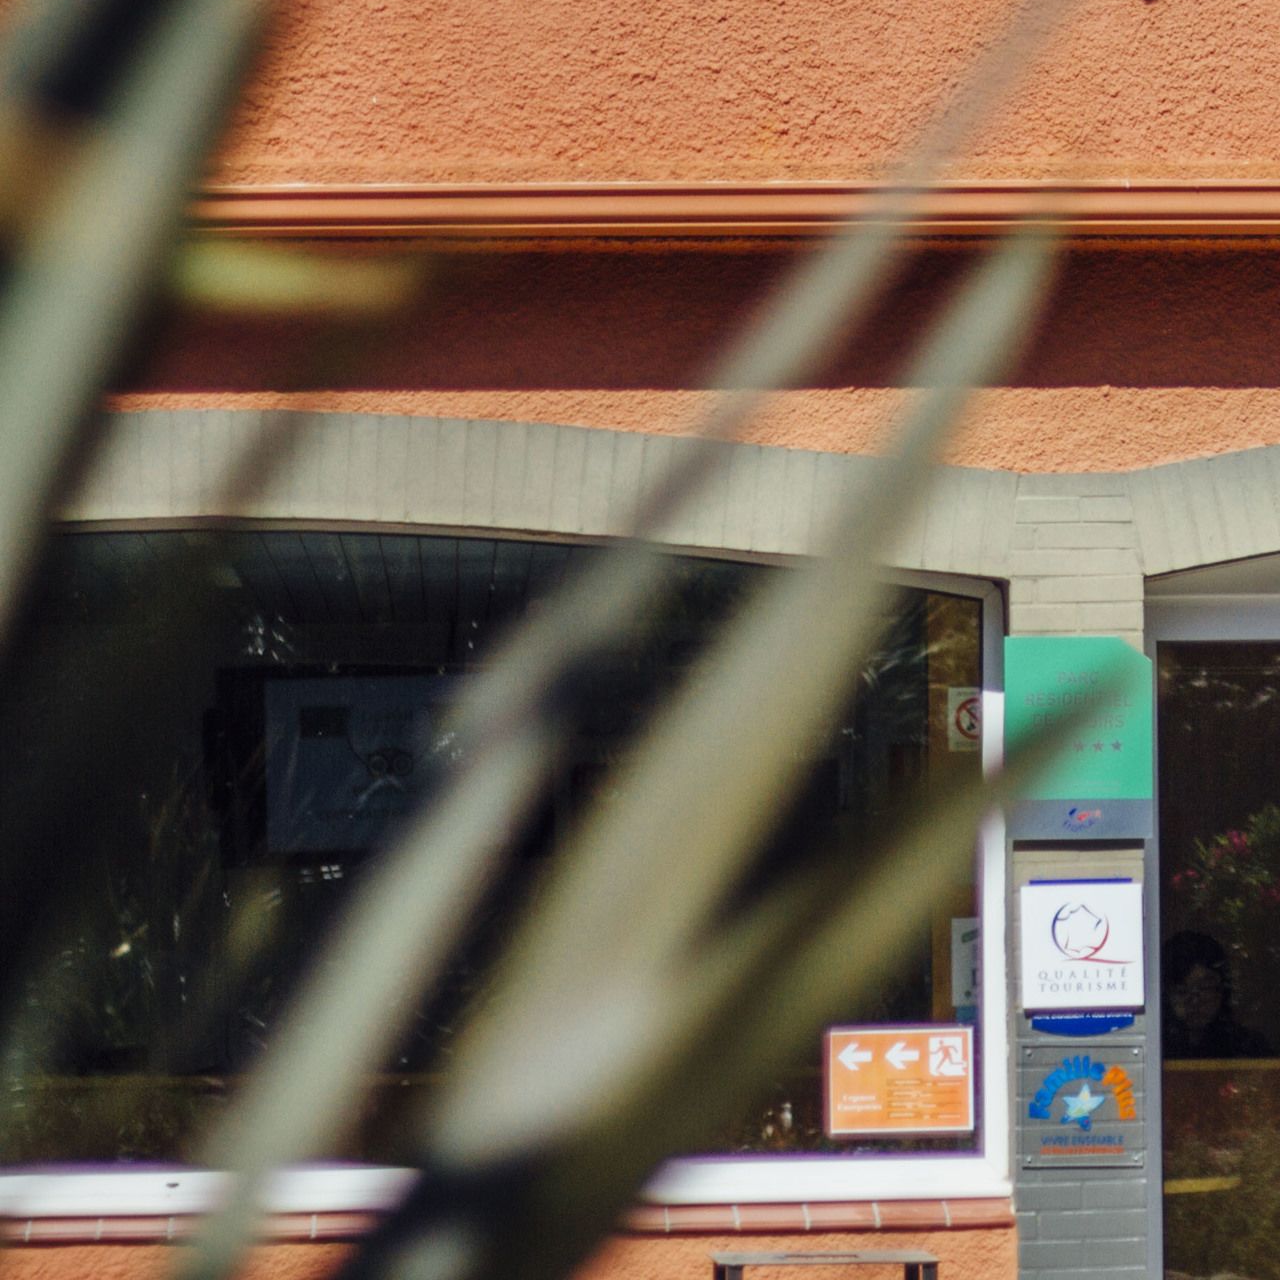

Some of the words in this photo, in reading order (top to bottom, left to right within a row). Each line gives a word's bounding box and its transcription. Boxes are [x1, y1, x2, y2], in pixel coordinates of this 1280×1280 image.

[1038, 966, 1128, 983] QUALITÉ
[1039, 981, 1128, 993] TOURISME
[1028, 1055, 1106, 1120] Famille
[1102, 1065, 1137, 1121] Plus
